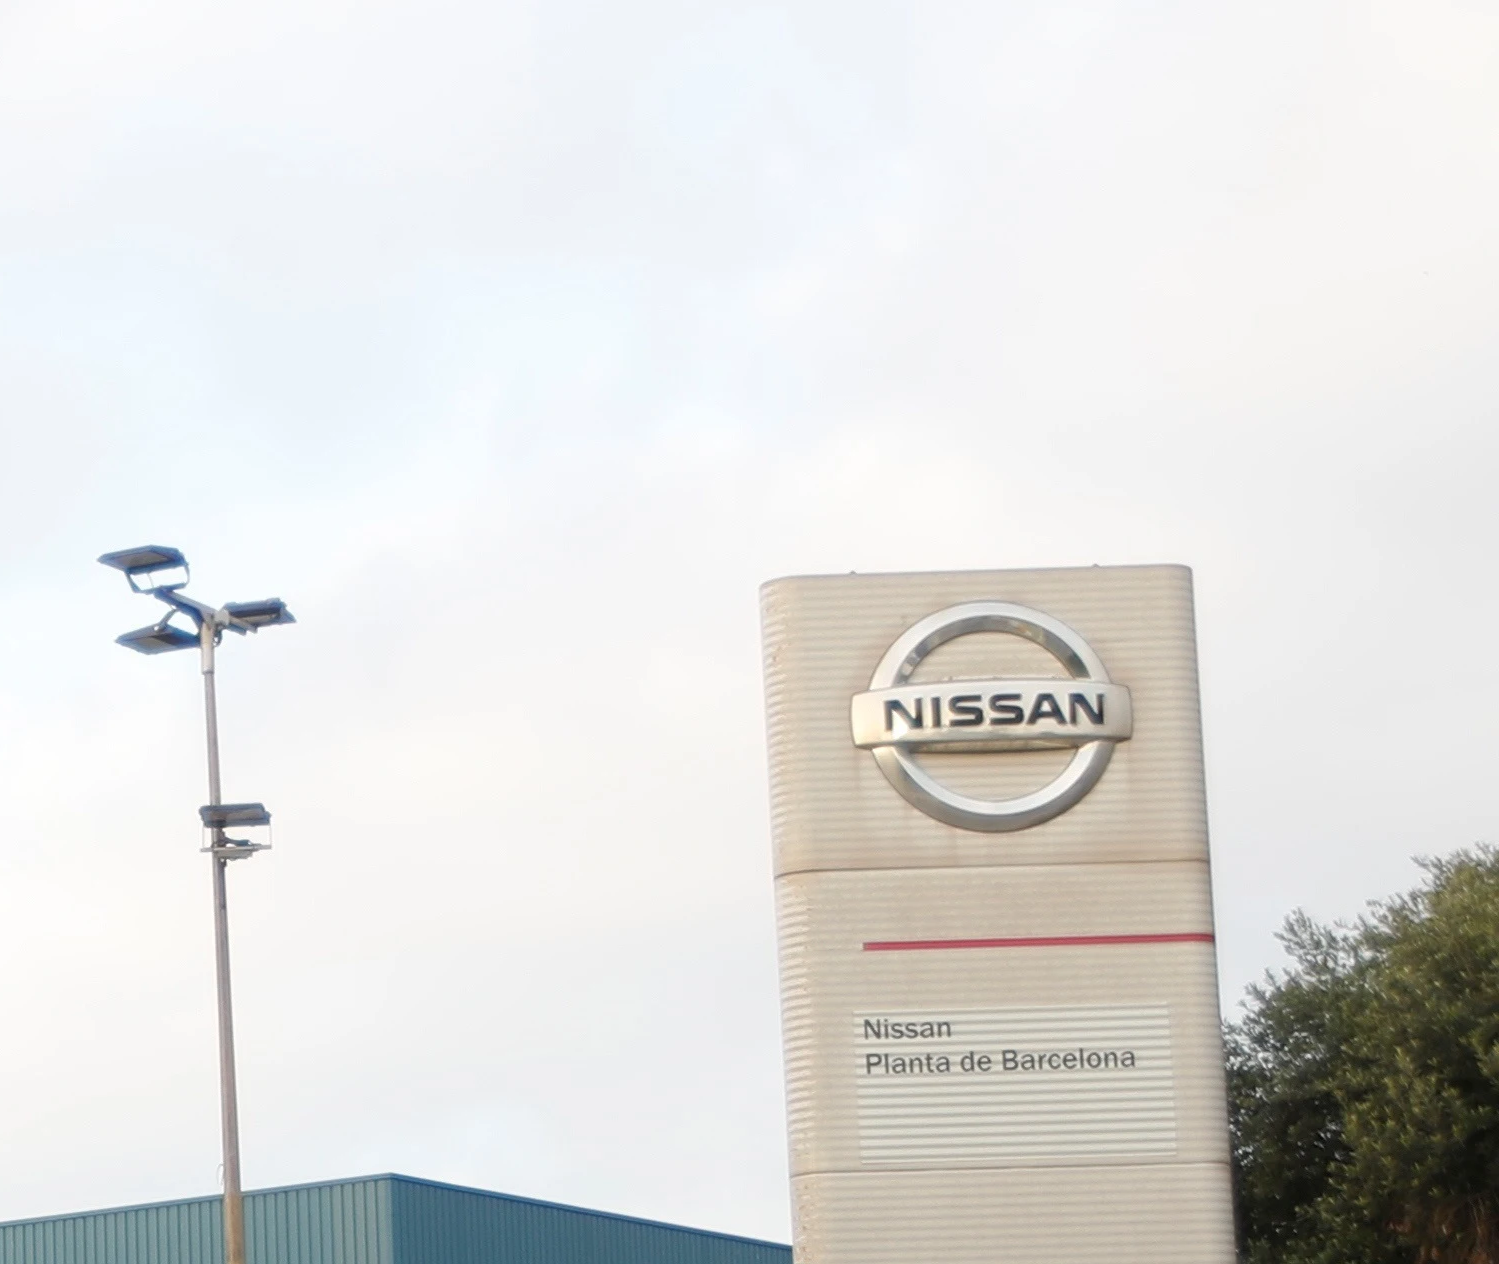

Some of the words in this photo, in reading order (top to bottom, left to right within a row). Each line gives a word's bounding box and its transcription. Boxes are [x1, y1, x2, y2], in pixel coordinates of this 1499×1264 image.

[883, 692, 1105, 732] NISSAN
[863, 1018, 952, 1040] Nissan
[865, 1052, 951, 1074] Planta
[960, 1051, 992, 1072] de
[1002, 1048, 1135, 1071] Barcelona
